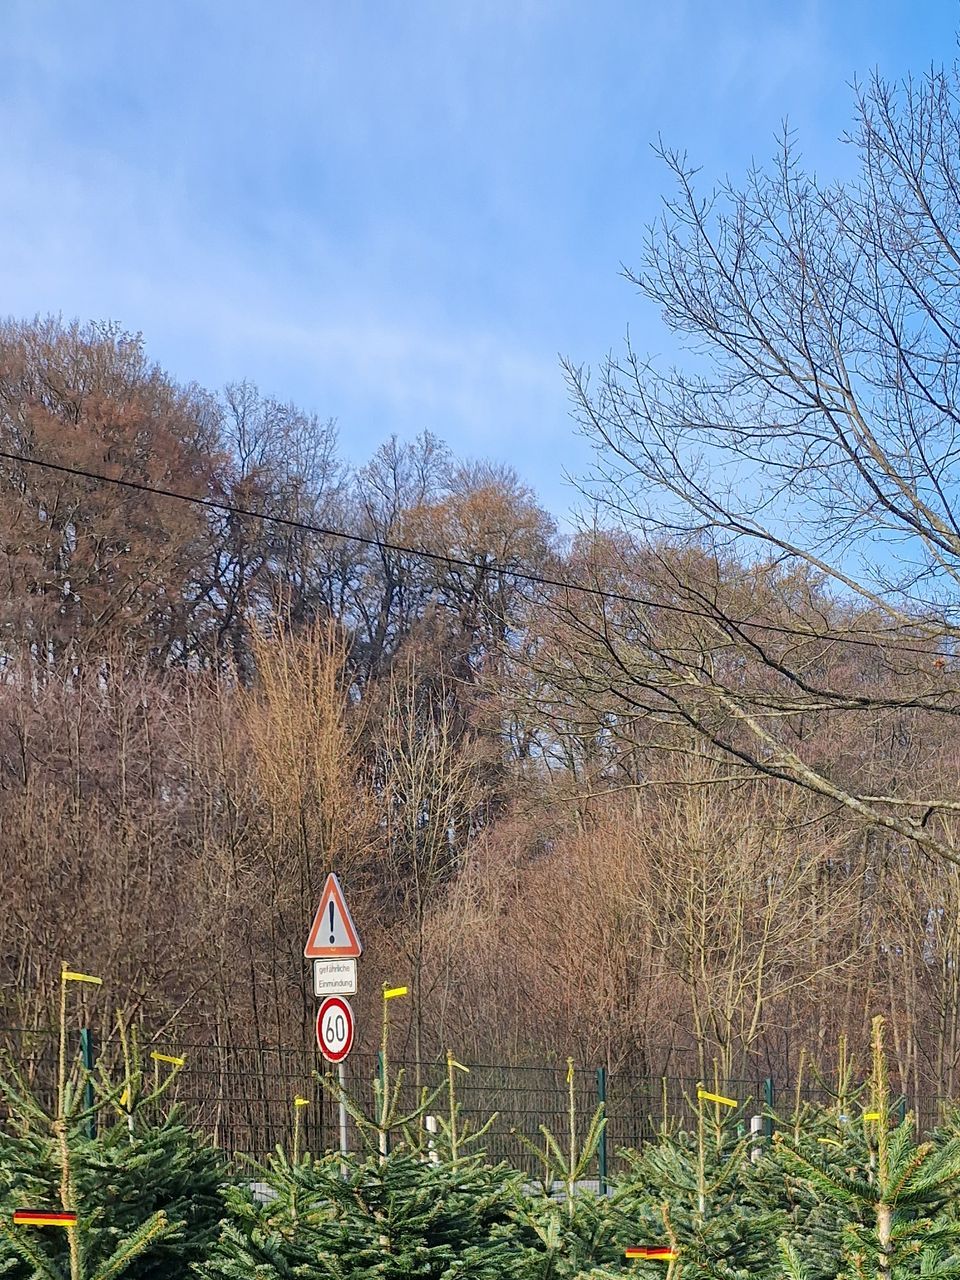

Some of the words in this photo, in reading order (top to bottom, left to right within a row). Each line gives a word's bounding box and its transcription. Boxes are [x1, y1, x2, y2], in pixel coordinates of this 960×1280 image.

[319, 965, 350, 974] gefährliche
[319, 979, 352, 988] Einmündung
[326, 1015, 345, 1043] 60
